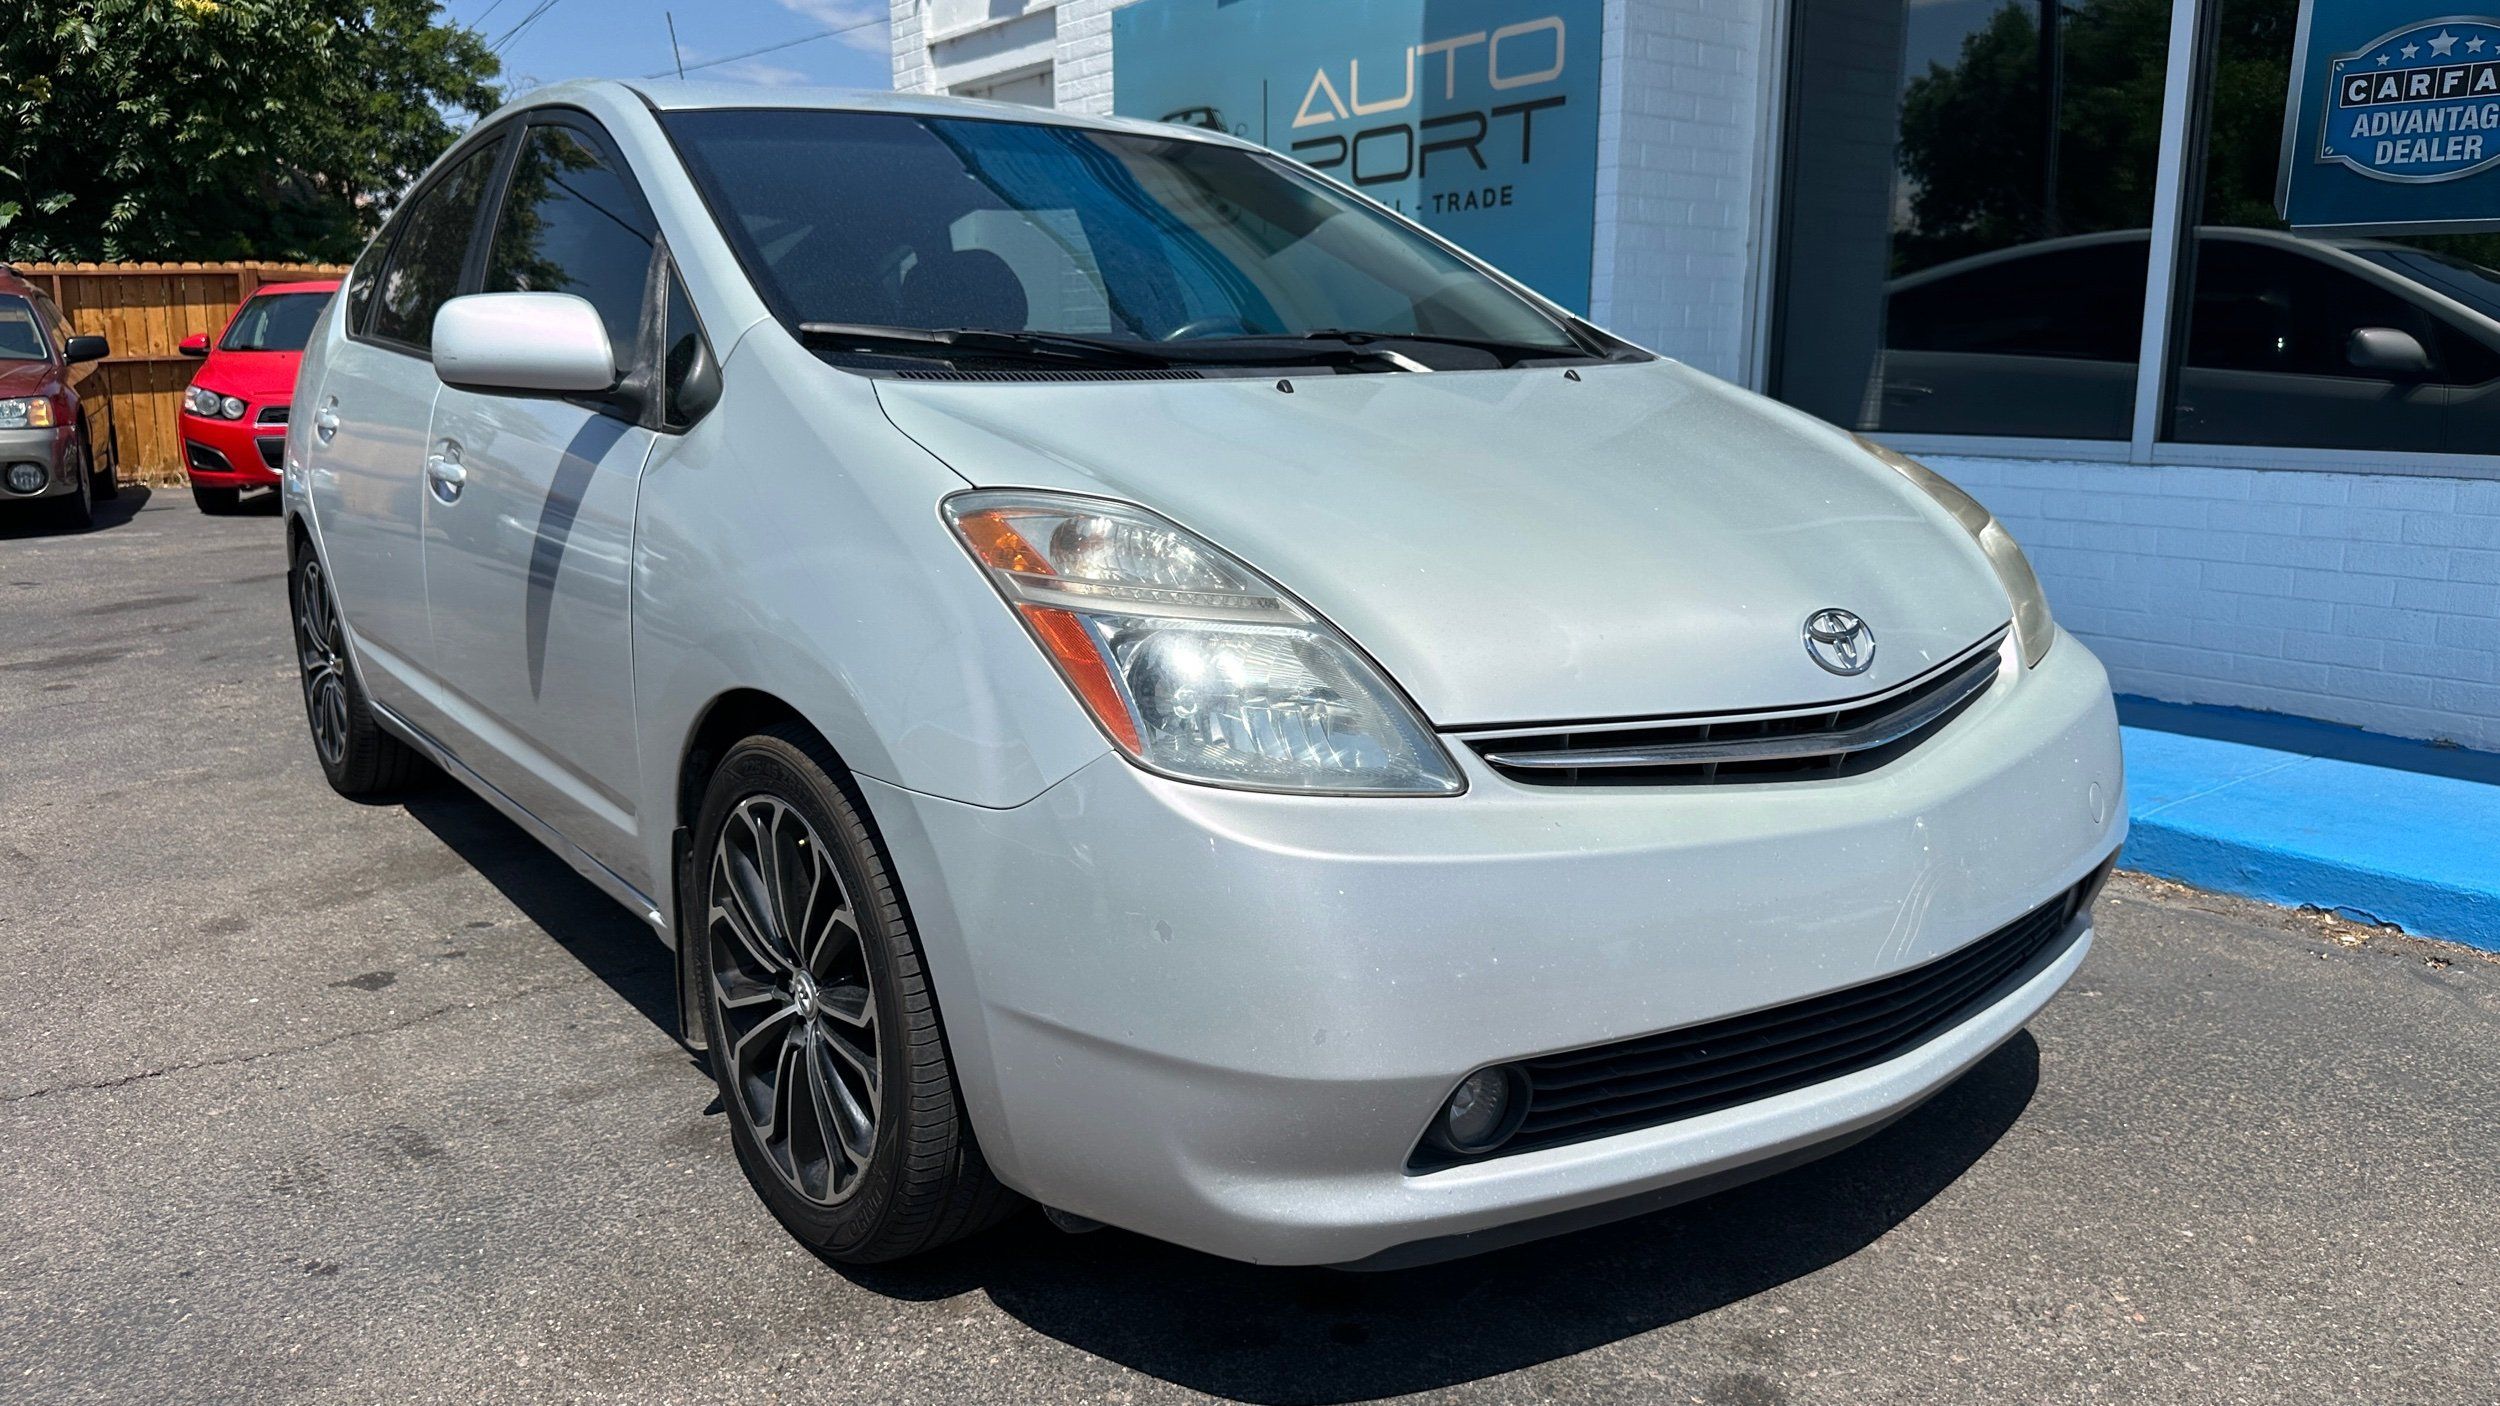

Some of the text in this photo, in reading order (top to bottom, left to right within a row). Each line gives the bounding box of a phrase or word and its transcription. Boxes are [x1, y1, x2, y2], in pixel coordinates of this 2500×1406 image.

[1291, 16, 1566, 129] AUTO
[2348, 67, 2498, 102] CARFA
[2351, 103, 2500, 138] ADVANTAG
[1291, 95, 1566, 186] PORT
[2374, 135, 2484, 165] DEALER
[1432, 185, 1513, 214] TRADE
